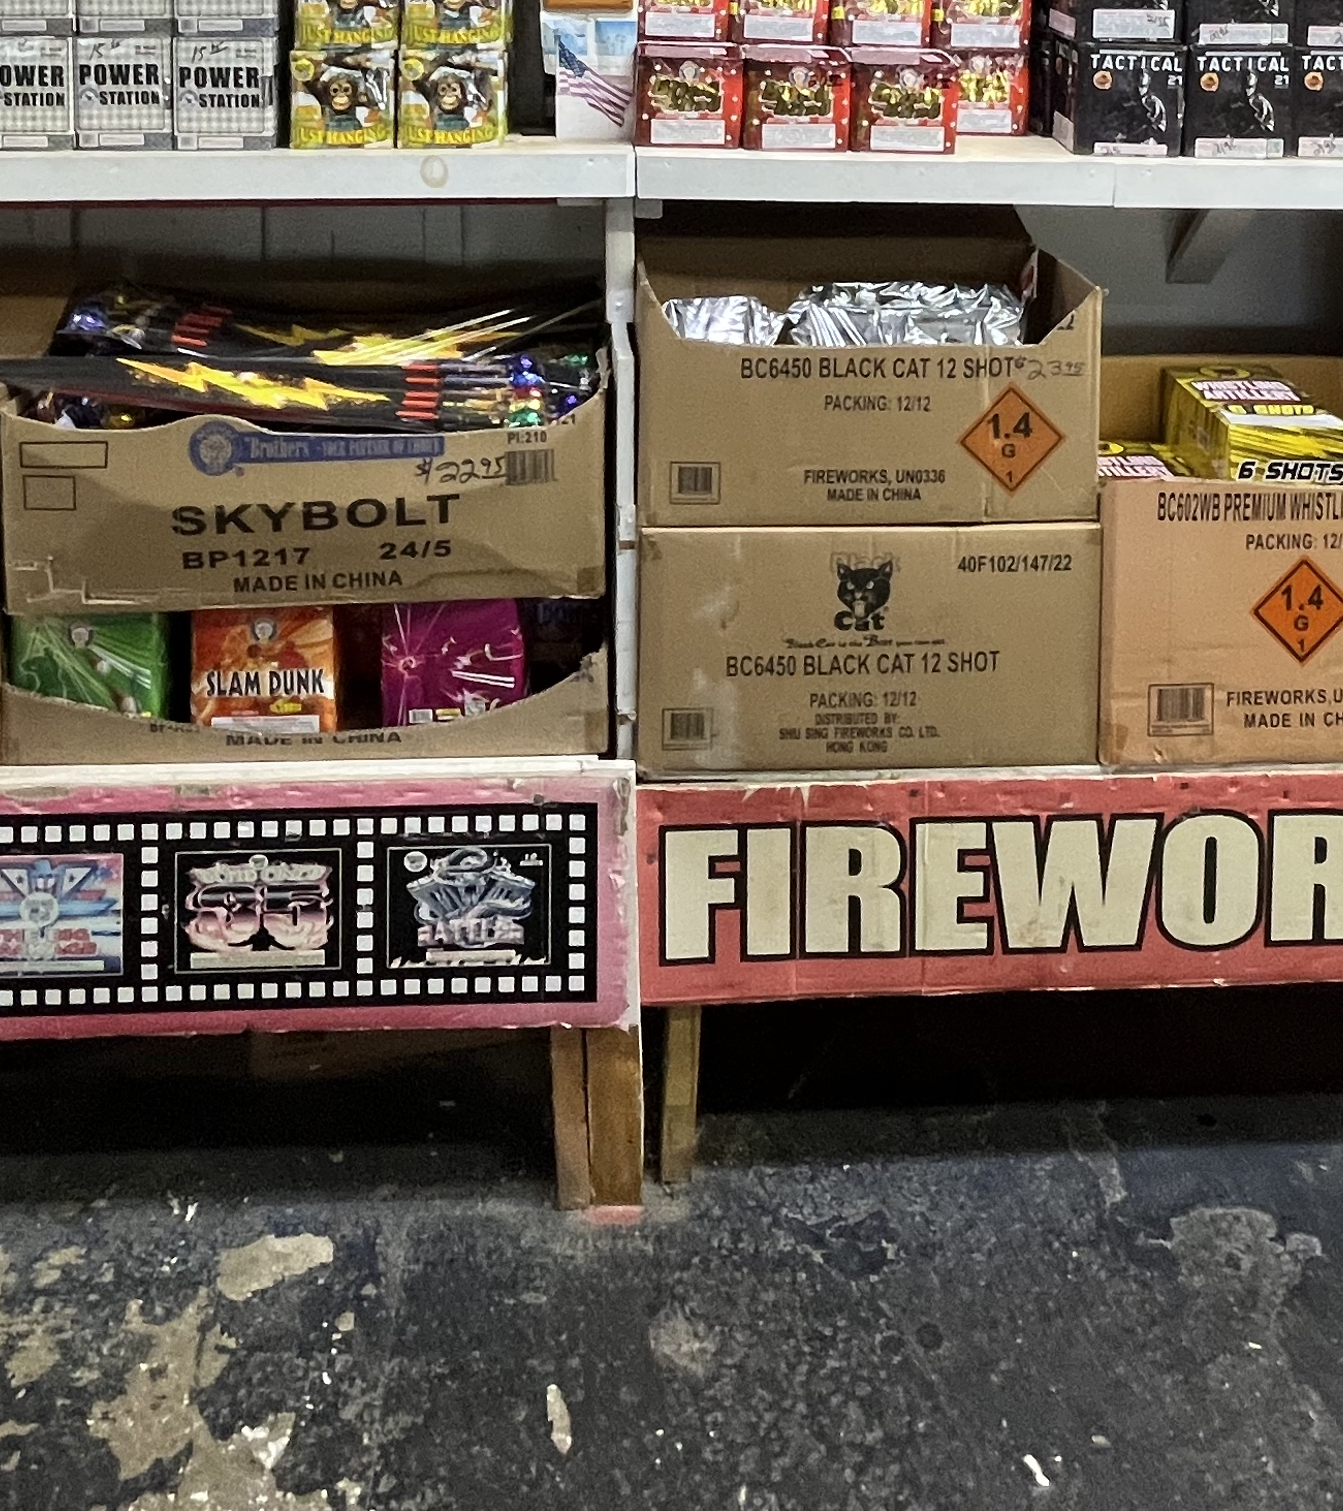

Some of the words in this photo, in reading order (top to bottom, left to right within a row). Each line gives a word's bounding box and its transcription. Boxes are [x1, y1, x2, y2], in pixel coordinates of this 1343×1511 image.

[1091, 54, 1182, 72] TACTICAL
[1197, 55, 1289, 72] TACTICAL
[79, 64, 160, 87] POWER
[1275, 76, 1289, 86] 21
[100, 91, 160, 106] STATION
[741, 357, 811, 379] BC6450
[819, 357, 888, 379] BLACK
[893, 357, 929, 378] CAT
[937, 357, 956, 378] 12
[962, 357, 1013, 378] SHOT
[824, 395, 892, 412] PACKING:
[897, 394, 931, 412] 12/12
[988, 412, 1033, 440] 1.4
[804, 470, 892, 485] FIREWORKS,
[1238, 462, 1256, 480] 6
[1264, 462, 1343, 480] SHOTS
[827, 489, 863, 502] MADE
[867, 489, 878, 502] IN
[882, 489, 921, 502] CHINA
[171, 493, 459, 537] SKYBOLT
[1158, 493, 1220, 522] BC602WB
[1224, 492, 1286, 521] PREMIUM
[1245, 533, 1318, 551] PACKING:
[182, 546, 310, 569] BP1217
[379, 540, 452, 560] 24/5
[958, 555, 1072, 573] 40F102/147/22
[233, 576, 297, 594] MADE
[305, 574, 328, 591] IN
[333, 569, 403, 589] CHINA
[1281, 585, 1323, 610] 1.4
[1294, 615, 1309, 631] G
[726, 655, 797, 677] BC6450
[803, 654, 870, 675] BLACK
[877, 653, 915, 673] CAT
[922, 652, 941, 673] 12
[947, 651, 1000, 672] SHOT
[206, 669, 260, 698] SLAM
[268, 668, 324, 695] DUNK
